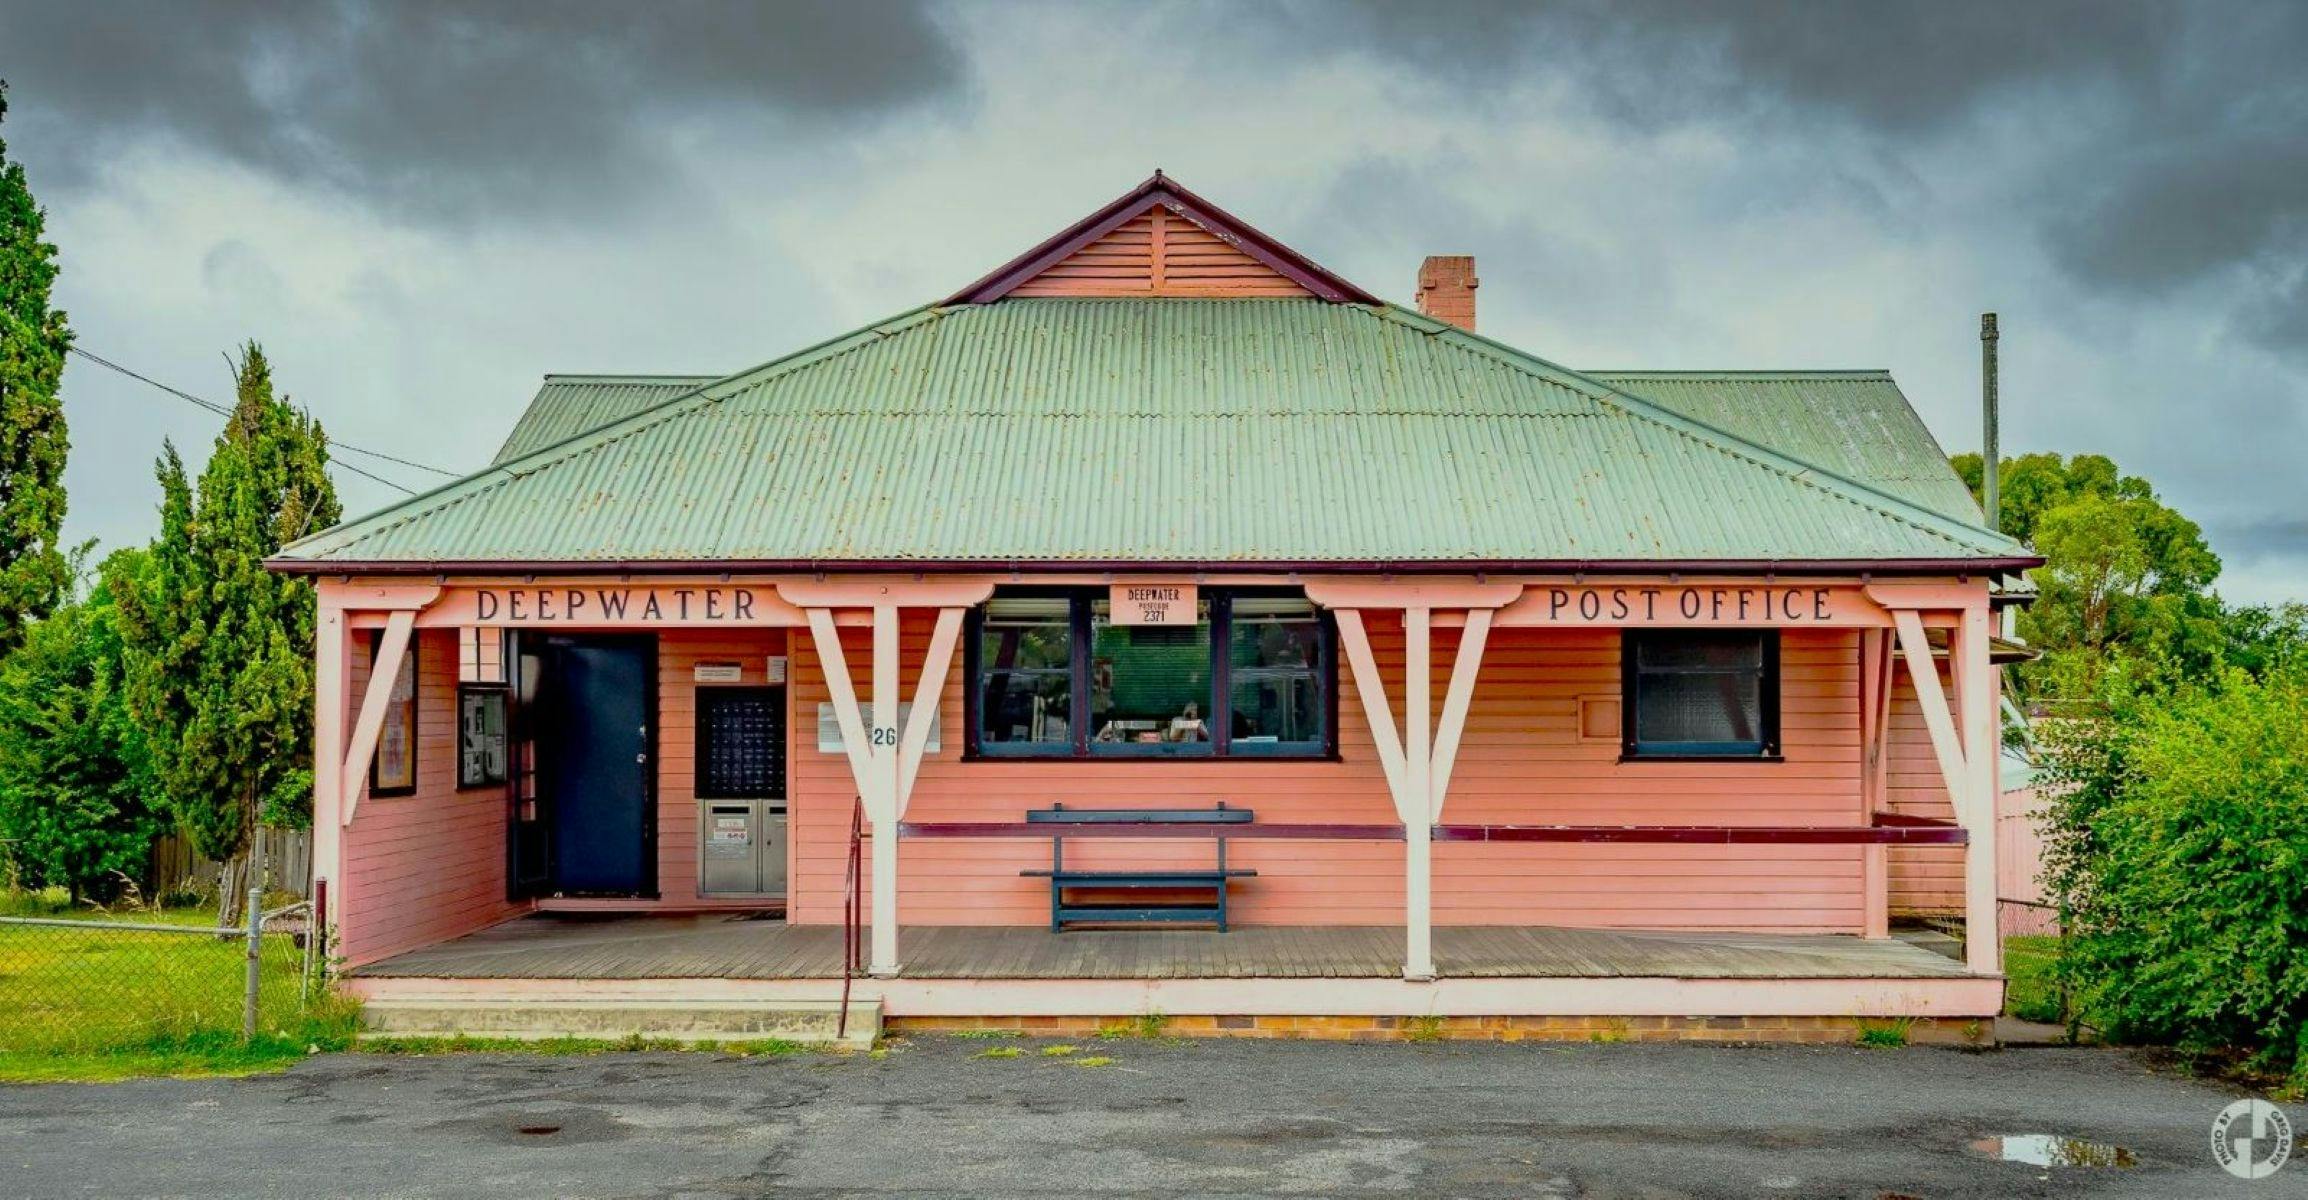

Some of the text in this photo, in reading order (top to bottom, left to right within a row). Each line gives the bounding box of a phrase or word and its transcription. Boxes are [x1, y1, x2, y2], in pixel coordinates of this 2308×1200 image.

[1128, 588, 1179, 600] DEEPWATER
[476, 589, 755, 620] DEEPWATER
[1549, 588, 1832, 620] POST OFFICE
[1144, 610, 1165, 622] 2371
[874, 728, 896, 746] 26
